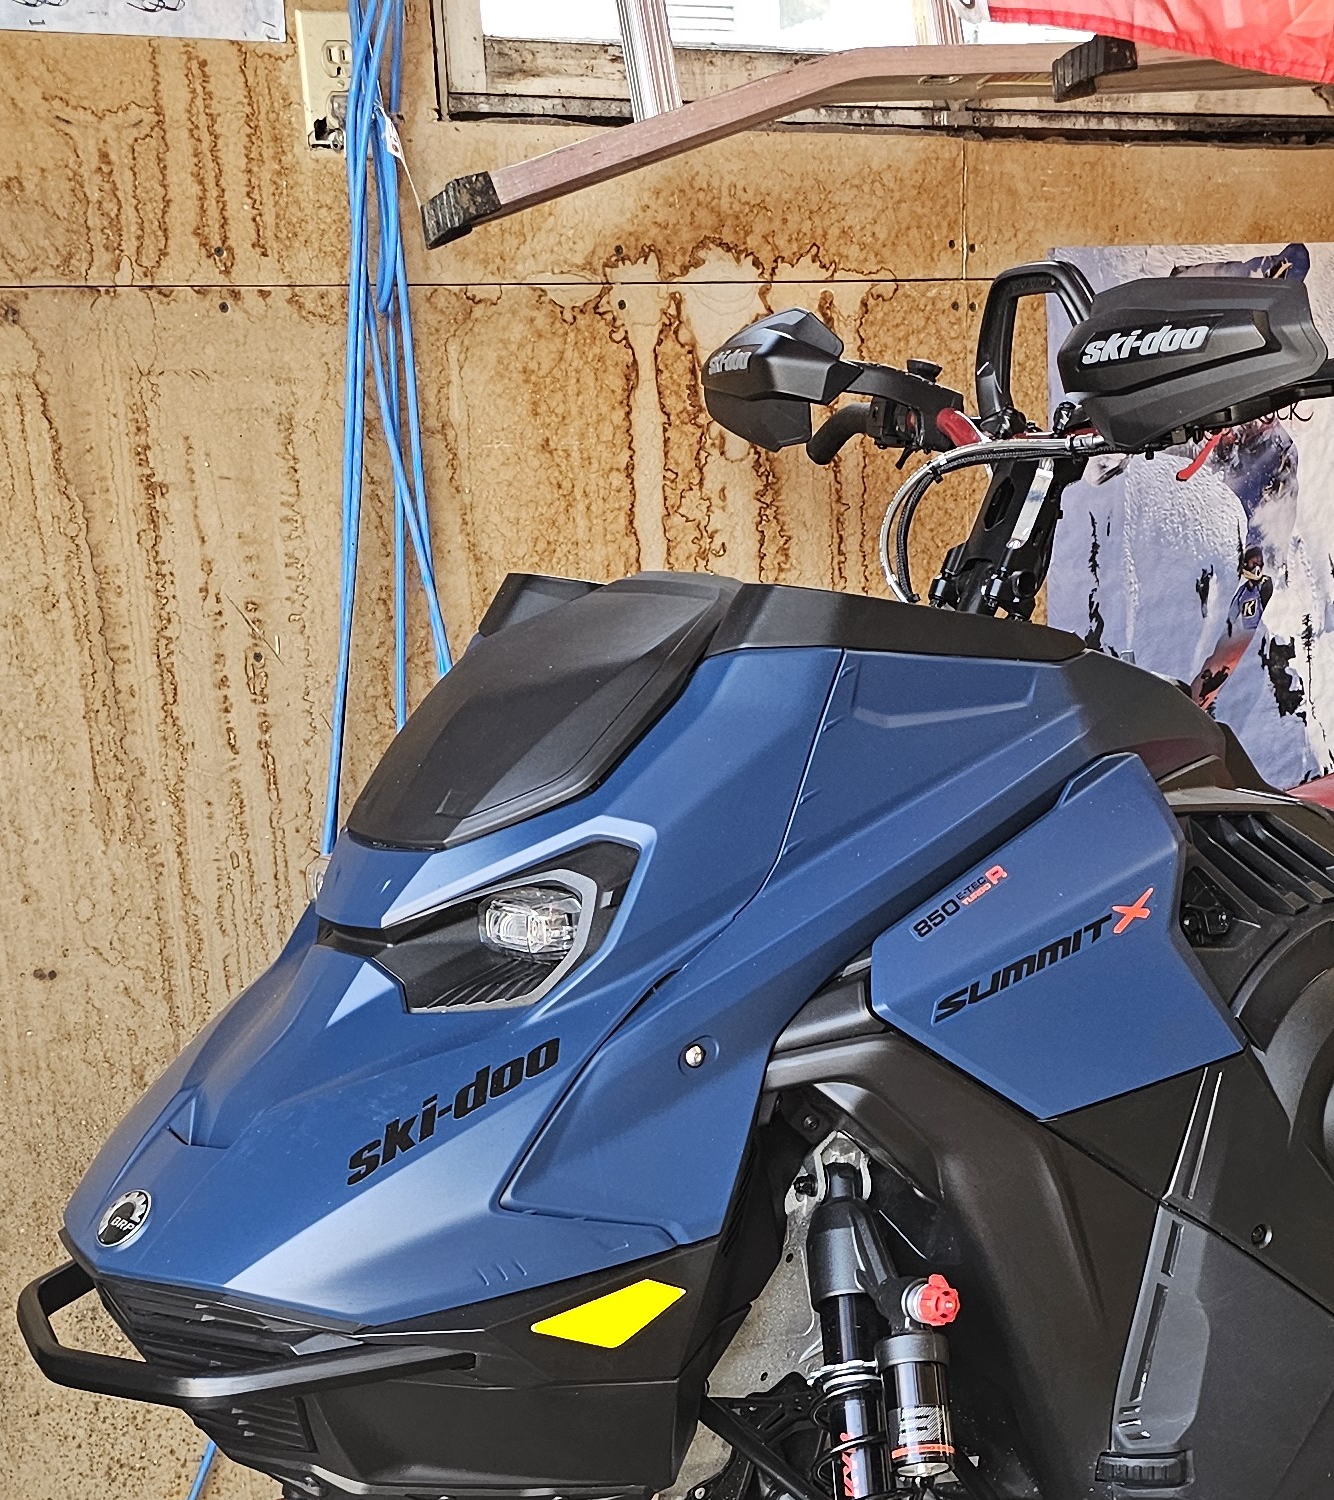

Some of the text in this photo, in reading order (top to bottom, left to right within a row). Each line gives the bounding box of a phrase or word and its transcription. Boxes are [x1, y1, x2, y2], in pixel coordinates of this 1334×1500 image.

[1082, 325, 1210, 365] ski-doo
[913, 898, 960, 938] 850
[955, 876, 987, 901] E-TEC
[934, 887, 1155, 1024] SUMMIT X
[346, 1037, 561, 1187] ski-doo
[110, 1216, 136, 1232] BRP
